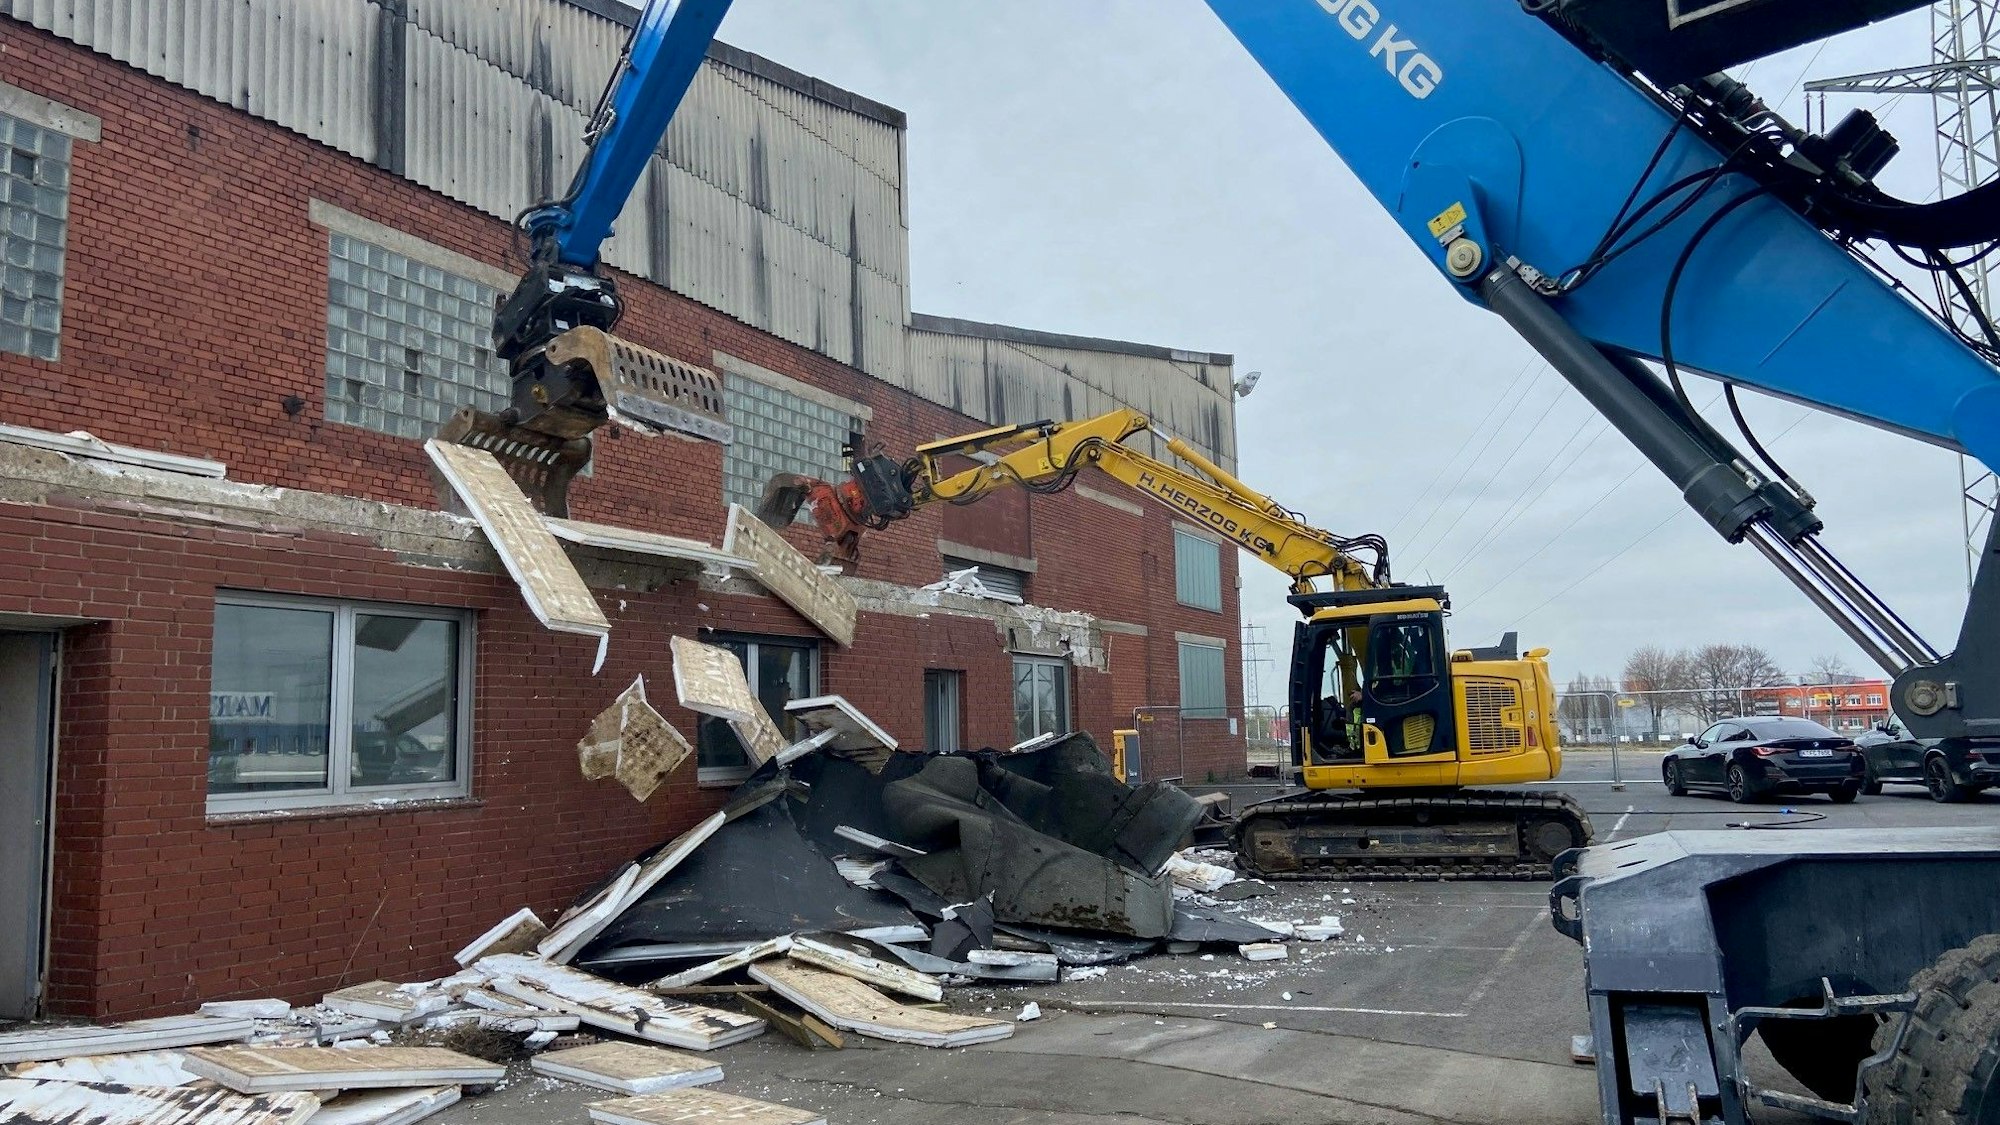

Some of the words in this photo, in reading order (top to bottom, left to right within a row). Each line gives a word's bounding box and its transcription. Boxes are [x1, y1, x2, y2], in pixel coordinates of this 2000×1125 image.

[1369, 24, 1443, 100] KG
[1140, 472, 1155, 488] H.
[1160, 483, 1238, 532] HERZOG
[1239, 528, 1268, 550] KG
